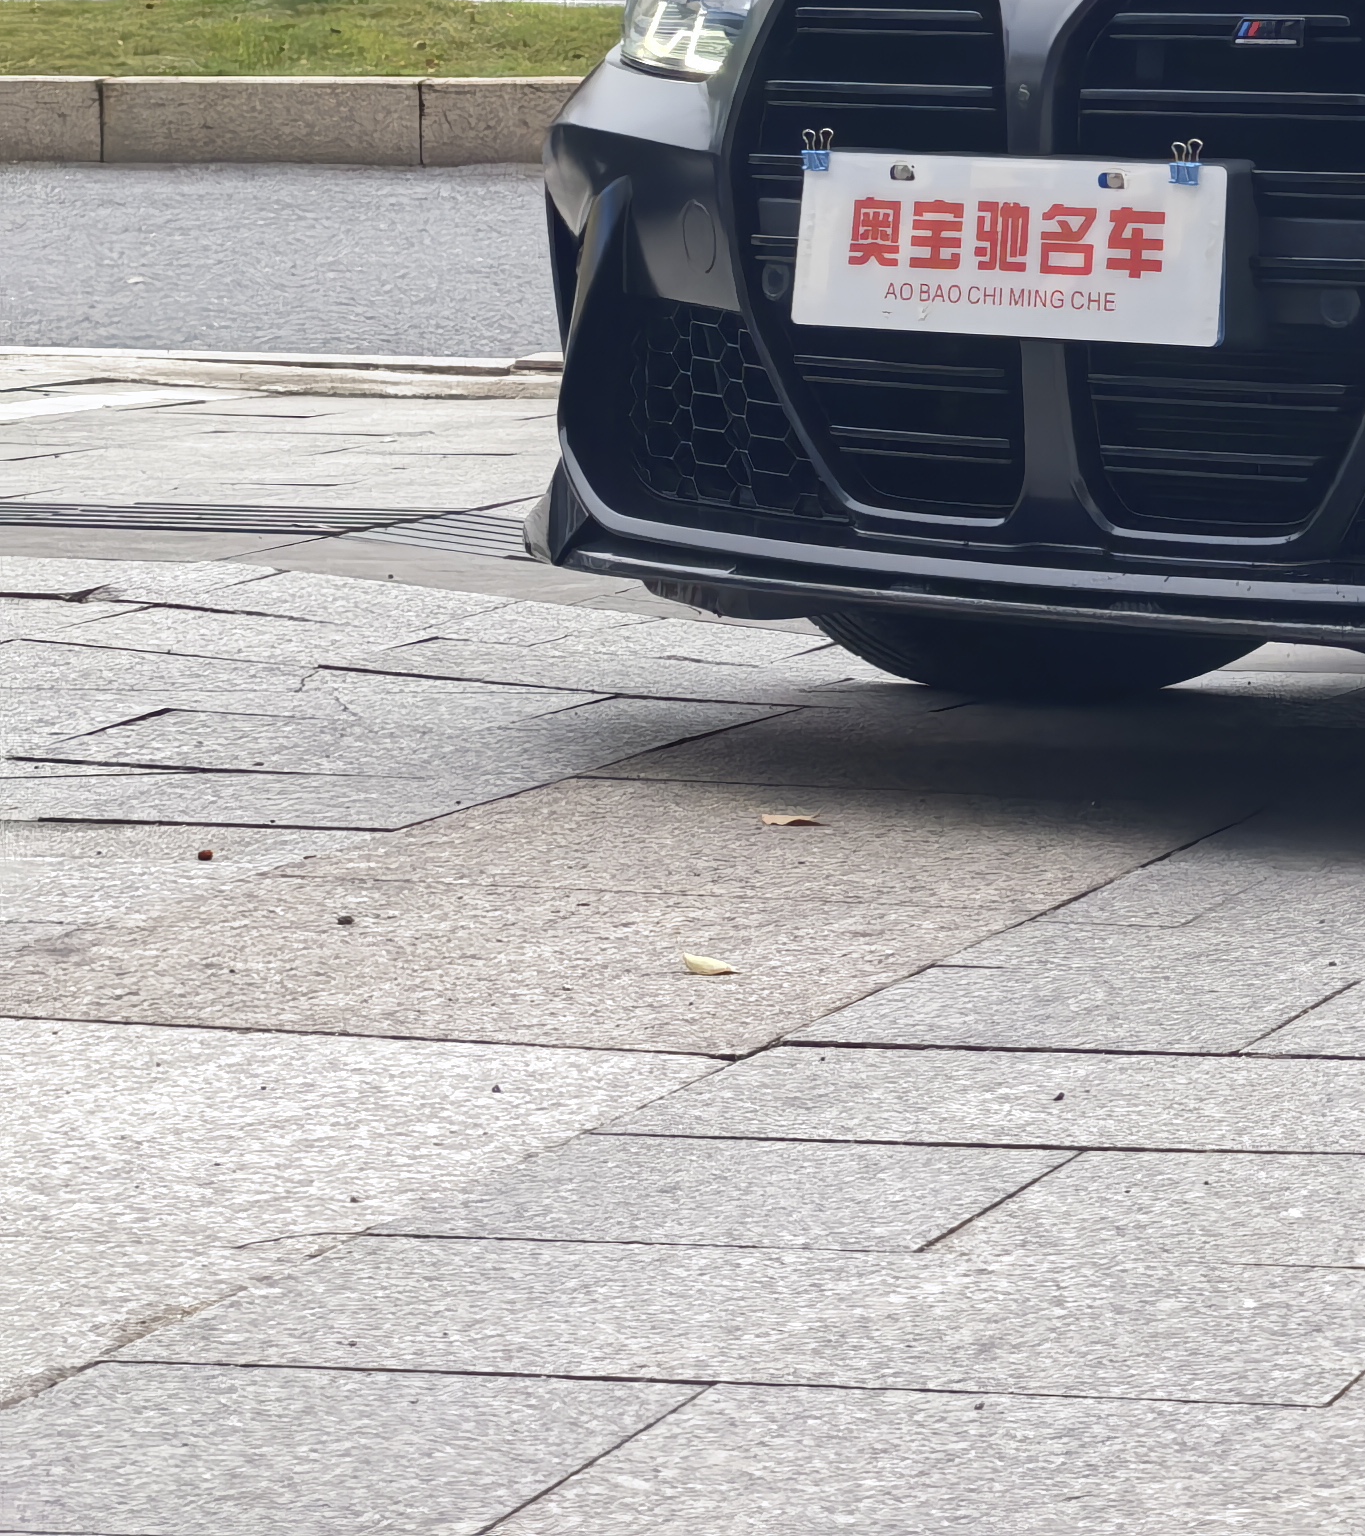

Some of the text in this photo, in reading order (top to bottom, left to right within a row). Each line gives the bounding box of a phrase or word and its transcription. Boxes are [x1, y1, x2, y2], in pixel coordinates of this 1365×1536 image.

[848, 196, 1167, 279] 奥宝驰名车
[884, 282, 1117, 312] AO BAO CHI MING CHE
